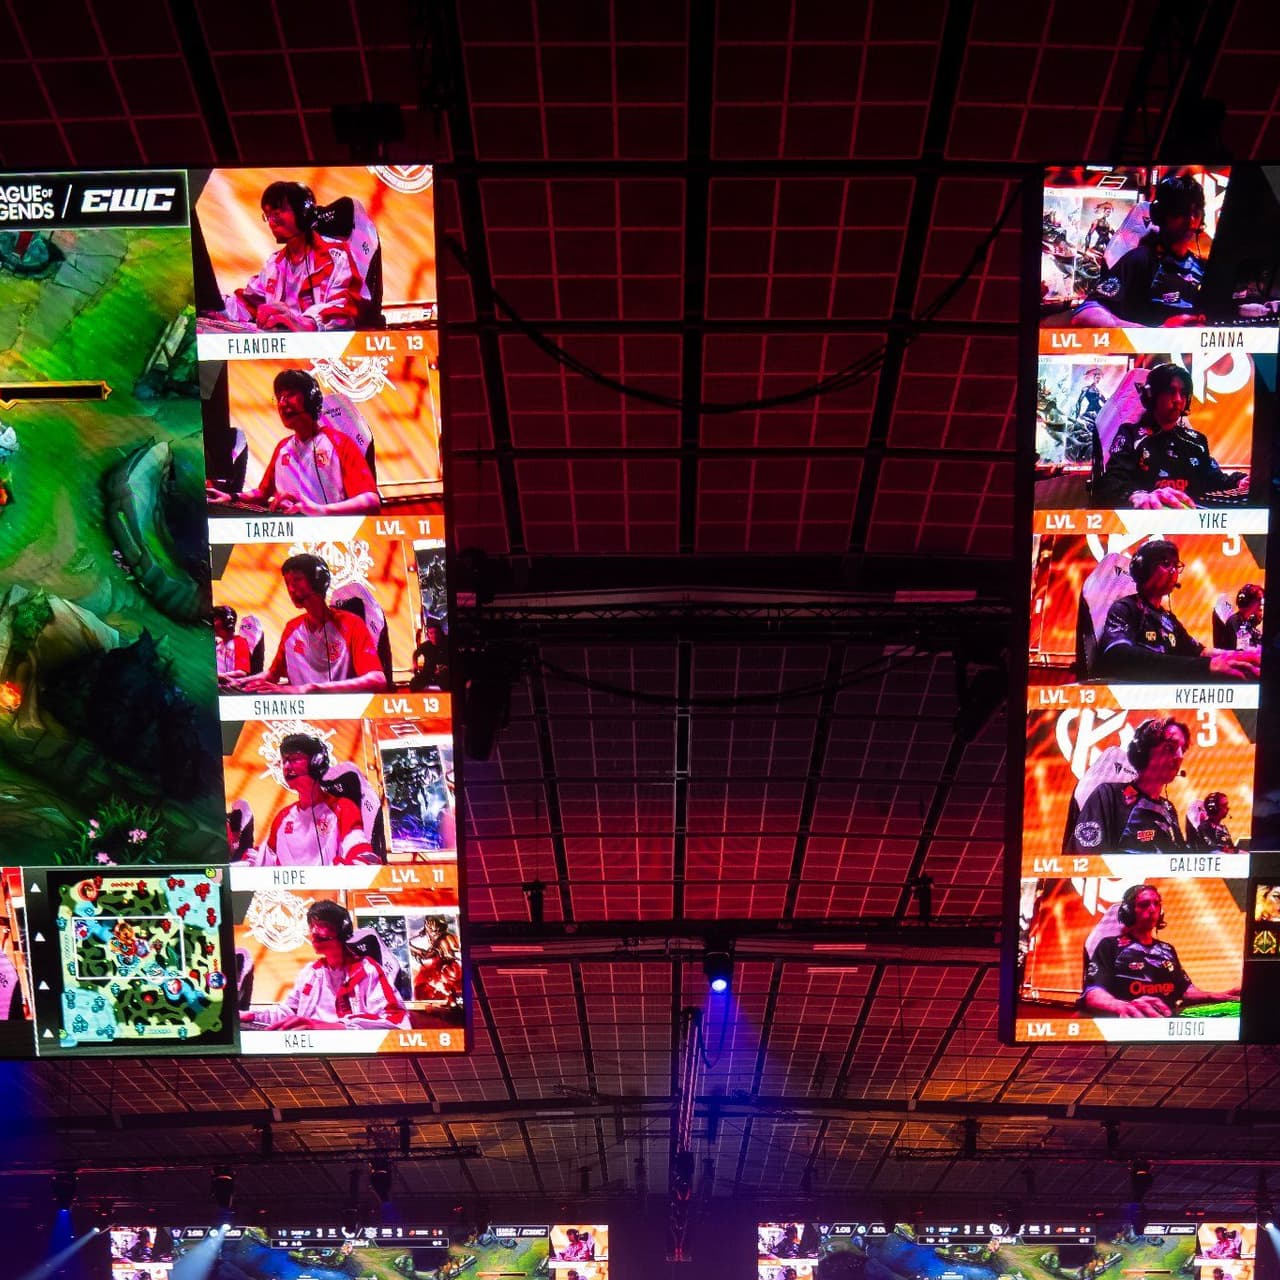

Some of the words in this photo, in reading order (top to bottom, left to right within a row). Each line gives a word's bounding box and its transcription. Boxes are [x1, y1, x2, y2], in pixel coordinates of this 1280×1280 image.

[81, 187, 176, 213] EWC
[228, 337, 287, 354] FLANDRE
[366, 336, 395, 351] LVL
[407, 335, 424, 350] 13
[1051, 333, 1081, 348] LVL
[1092, 332, 1110, 347] 14
[1200, 331, 1244, 348] CANNA
[246, 521, 294, 537] TARZAN
[376, 520, 405, 535] LVL
[418, 520, 430, 534] 11
[1046, 514, 1075, 529] LVL
[1086, 514, 1103, 528] 12
[1199, 512, 1228, 528] YIKE
[1040, 690, 1068, 703] LVL
[1080, 689, 1095, 703] 13
[1175, 688, 1234, 703] KYEAHOO
[254, 700, 305, 715] SHANKS
[384, 698, 412, 713] LVL
[423, 698, 439, 713] 13
[1197, 708, 1217, 747] 3
[1033, 858, 1062, 873] LVL
[1073, 858, 1088, 872] 12
[1170, 857, 1221, 872] CALISTE
[273, 870, 305, 885] HOPE
[391, 869, 419, 883] LVL
[433, 869, 444, 883] 11
[1028, 1023, 1055, 1037] LVL
[1068, 1023, 1079, 1036] 8
[1168, 1021, 1205, 1036] BUSIO
[284, 1034, 314, 1048] KAEL
[399, 1034, 427, 1047] LVL
[440, 1034, 451, 1047] 8
